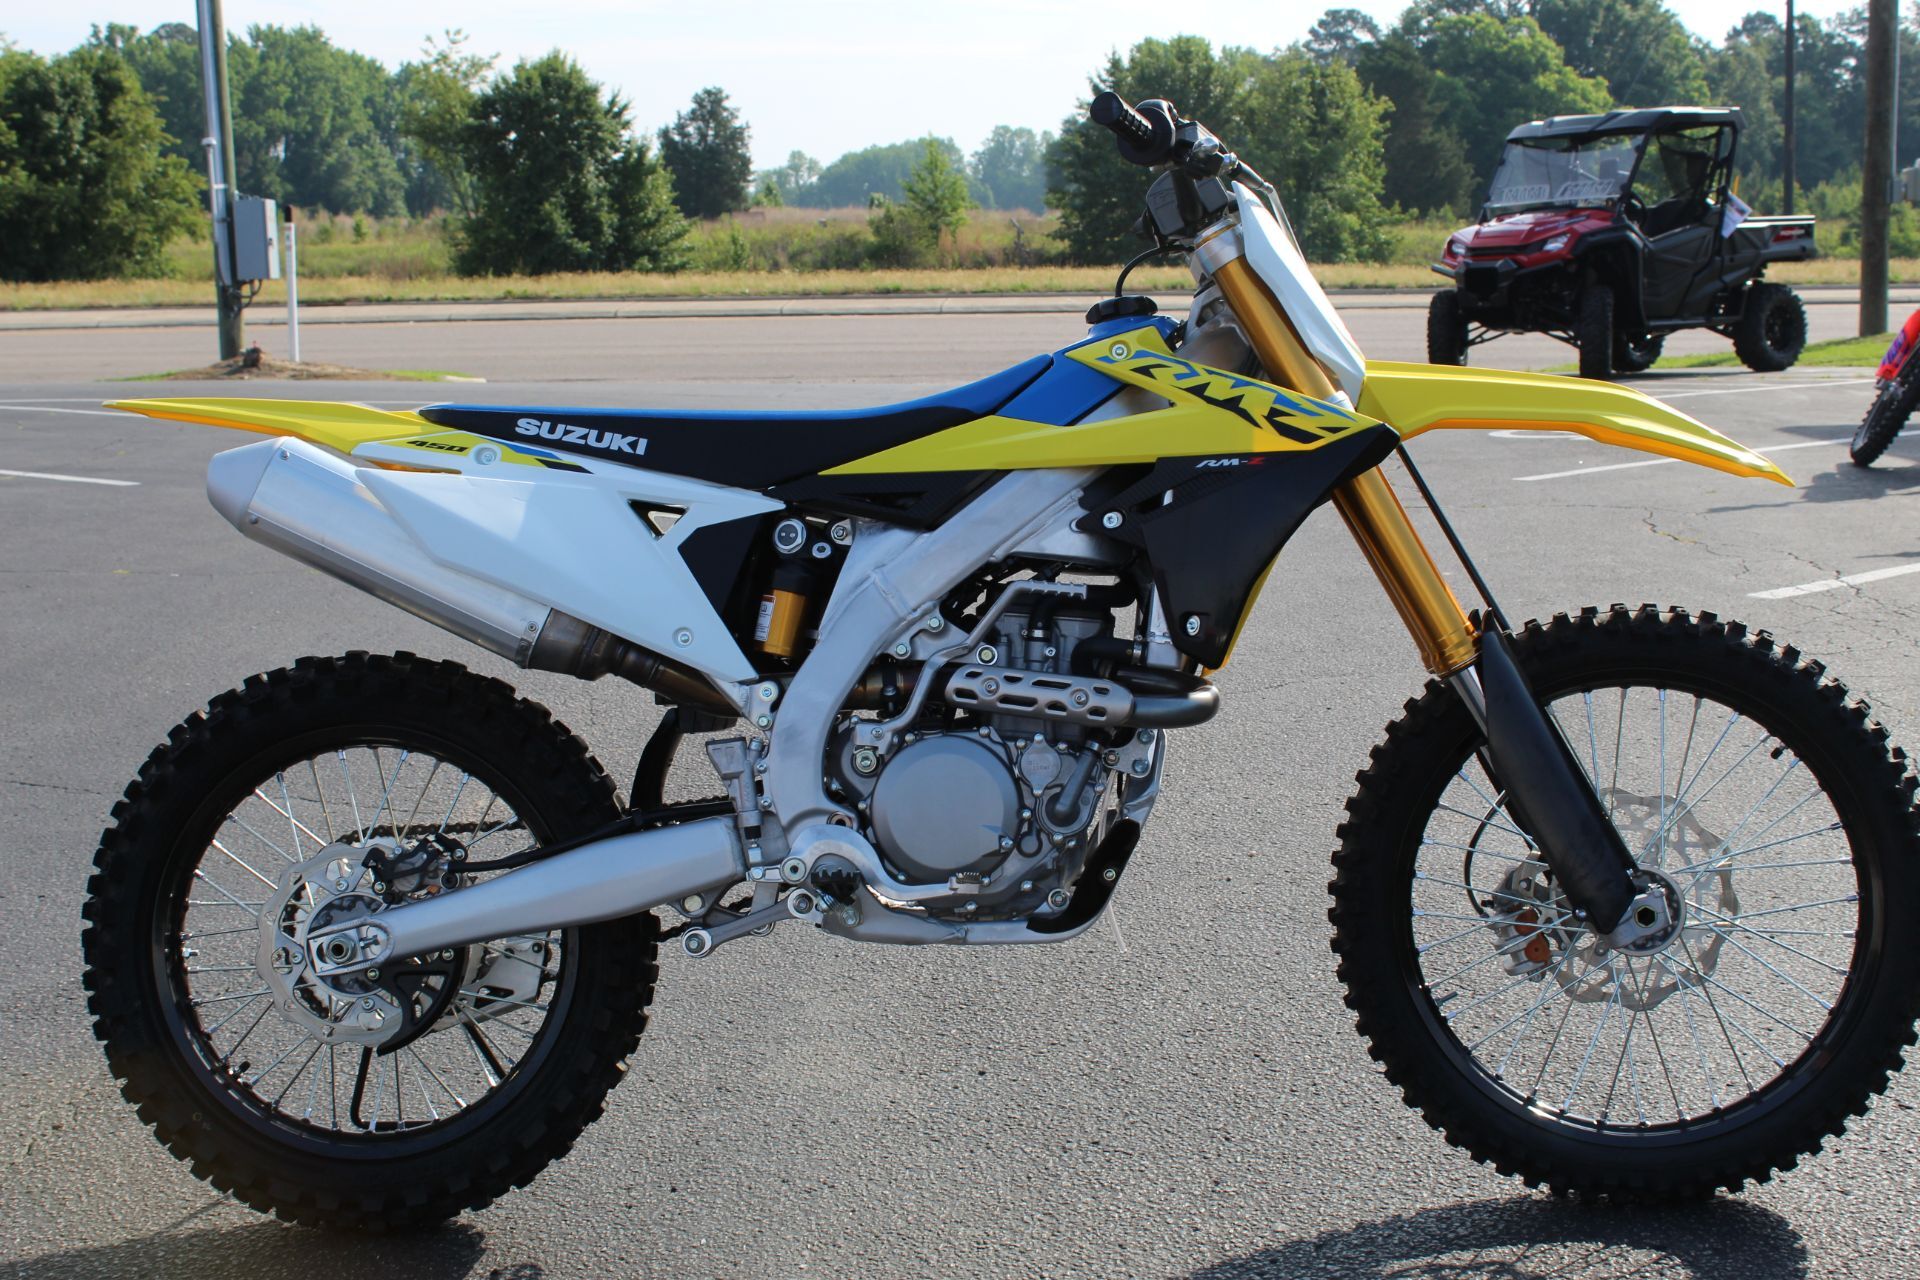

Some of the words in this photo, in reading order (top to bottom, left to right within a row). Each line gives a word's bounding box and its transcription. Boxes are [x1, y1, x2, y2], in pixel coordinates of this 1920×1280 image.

[515, 418, 648, 456] SUZUKI
[406, 440, 468, 453] 450
[1196, 456, 1264, 468] RM-Z
